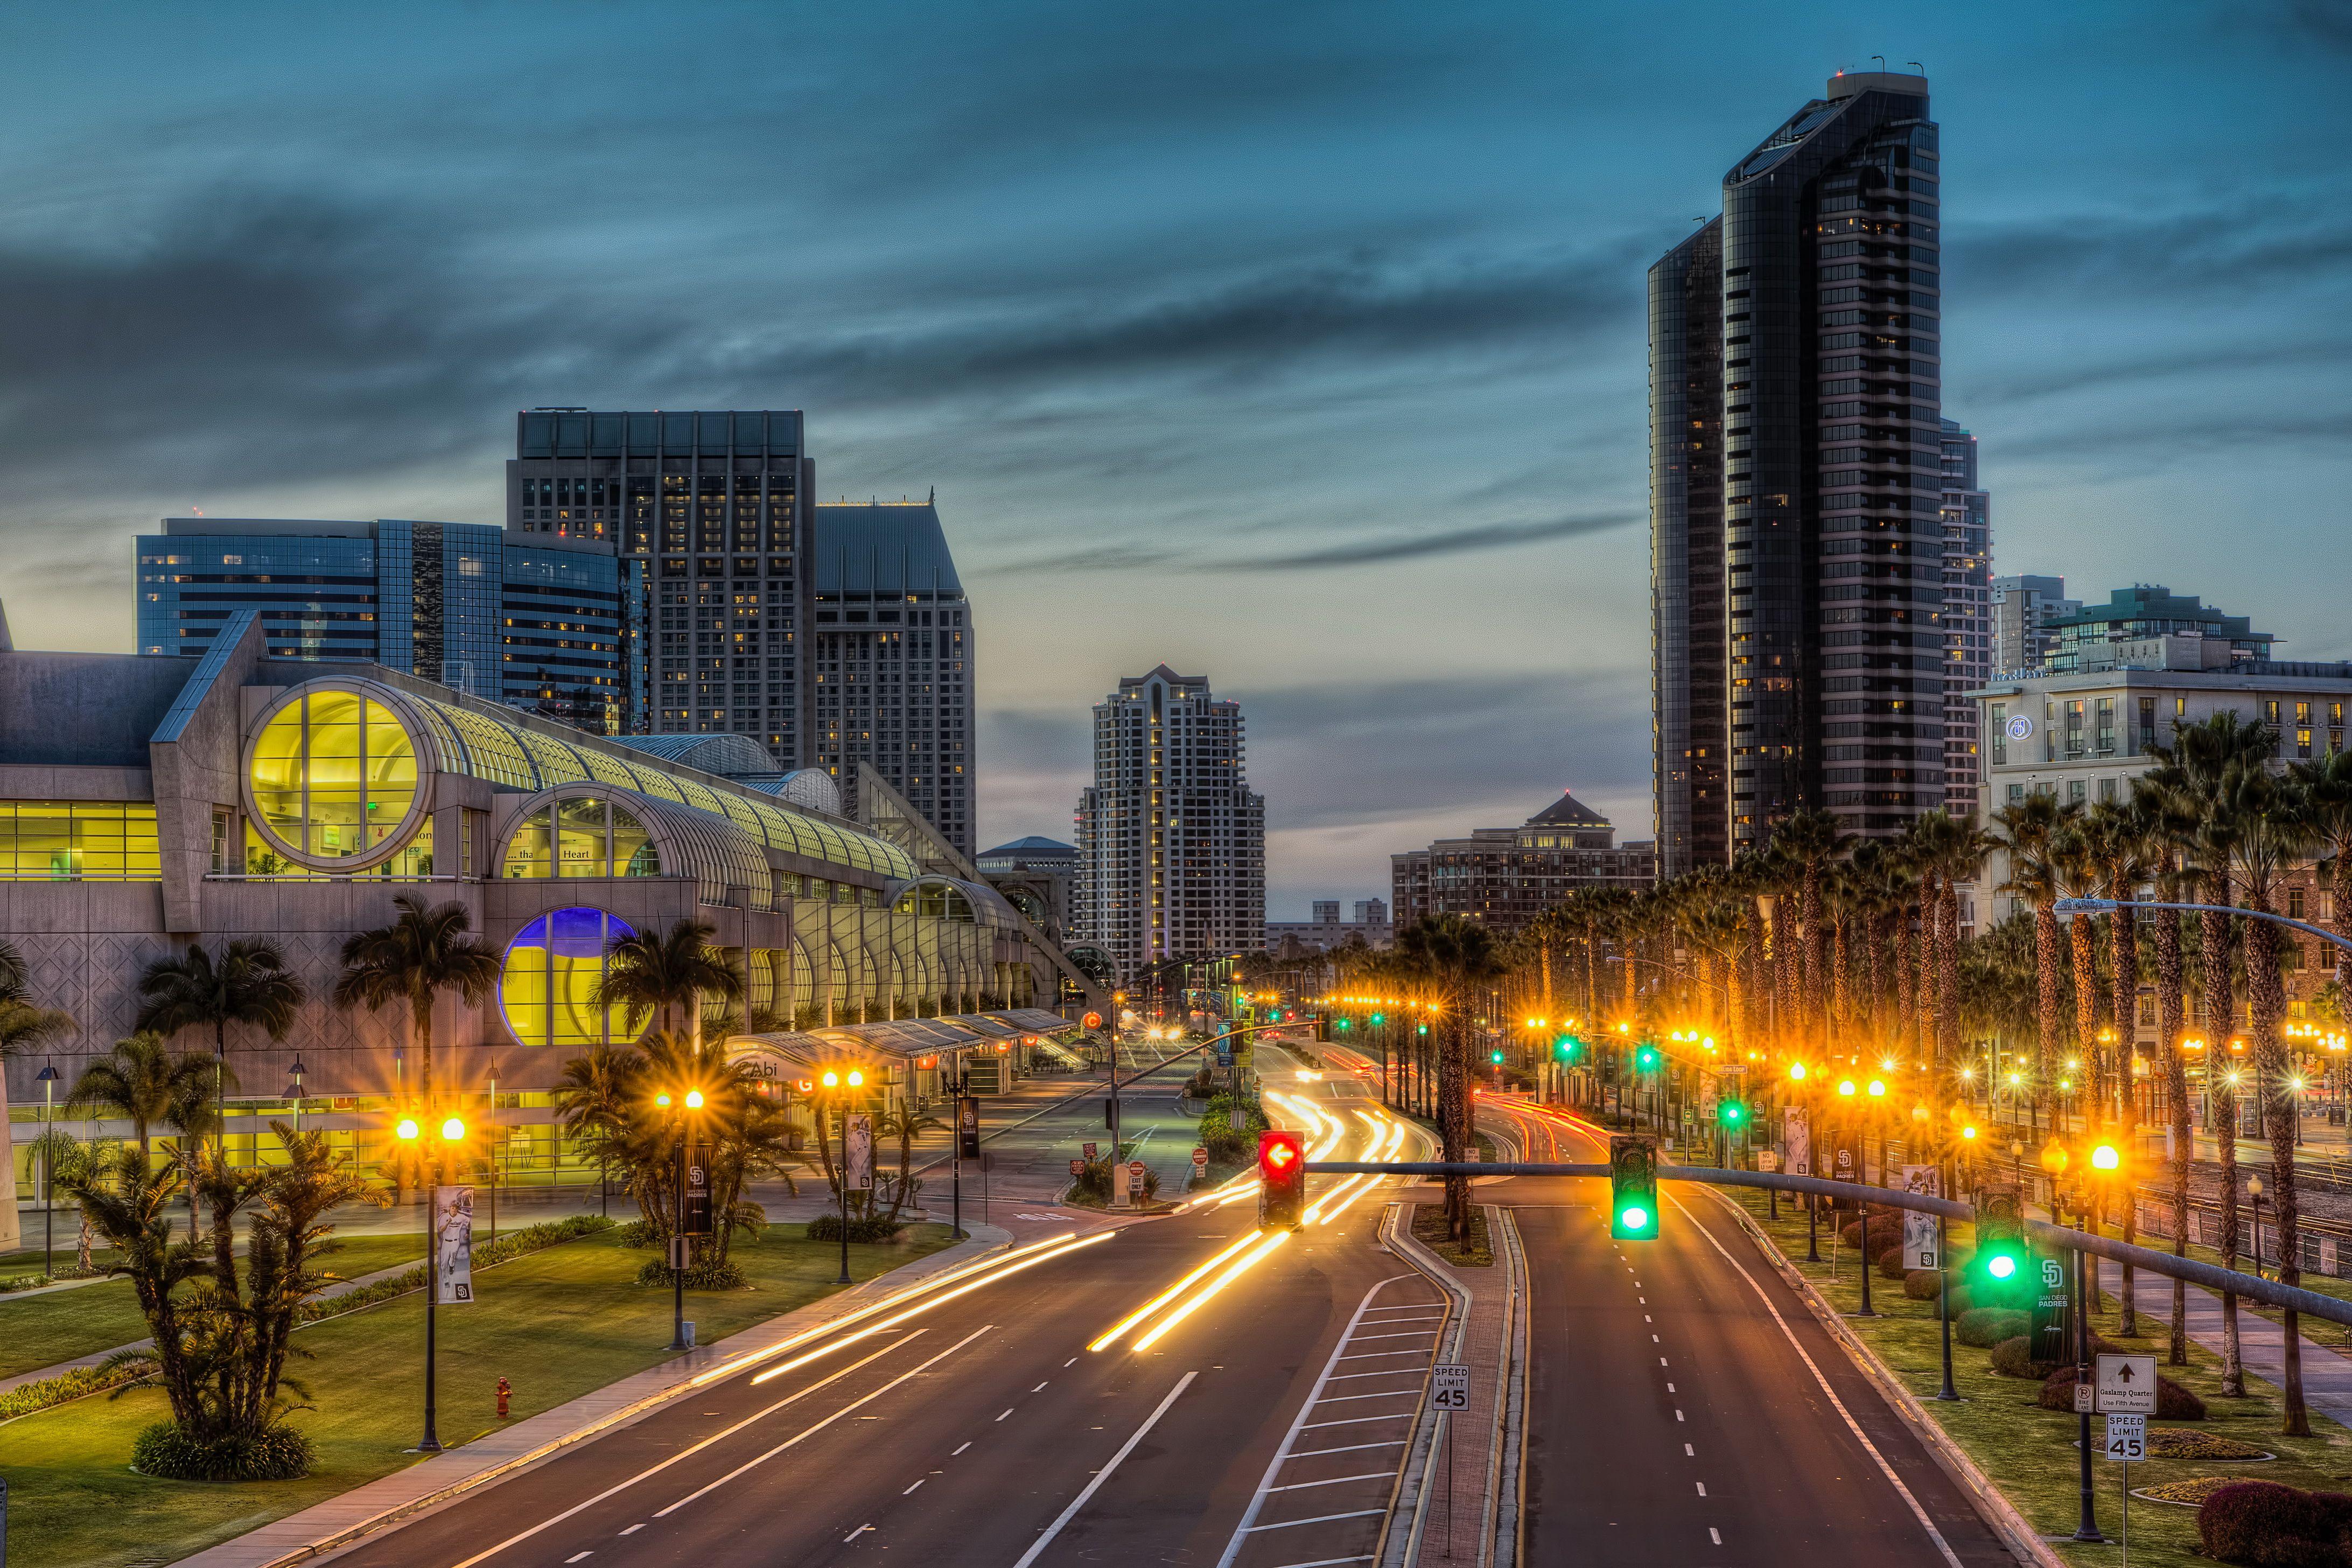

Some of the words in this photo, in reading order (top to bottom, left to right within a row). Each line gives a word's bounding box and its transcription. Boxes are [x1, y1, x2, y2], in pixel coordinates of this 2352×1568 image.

[564, 850, 589, 858] Heart
[1088, 1016, 1097, 1027] C
[690, 1166, 704, 1185] SD
[1923, 1254, 1932, 1265] SD
[2042, 1259, 2063, 1288] SD
[458, 1286, 467, 1298] SD
[1434, 1368, 1468, 1376] SPEED
[1435, 1390, 1465, 1407] 45
[2109, 1417, 2144, 1425] SPEED
[2110, 1439, 2141, 1457] 45
